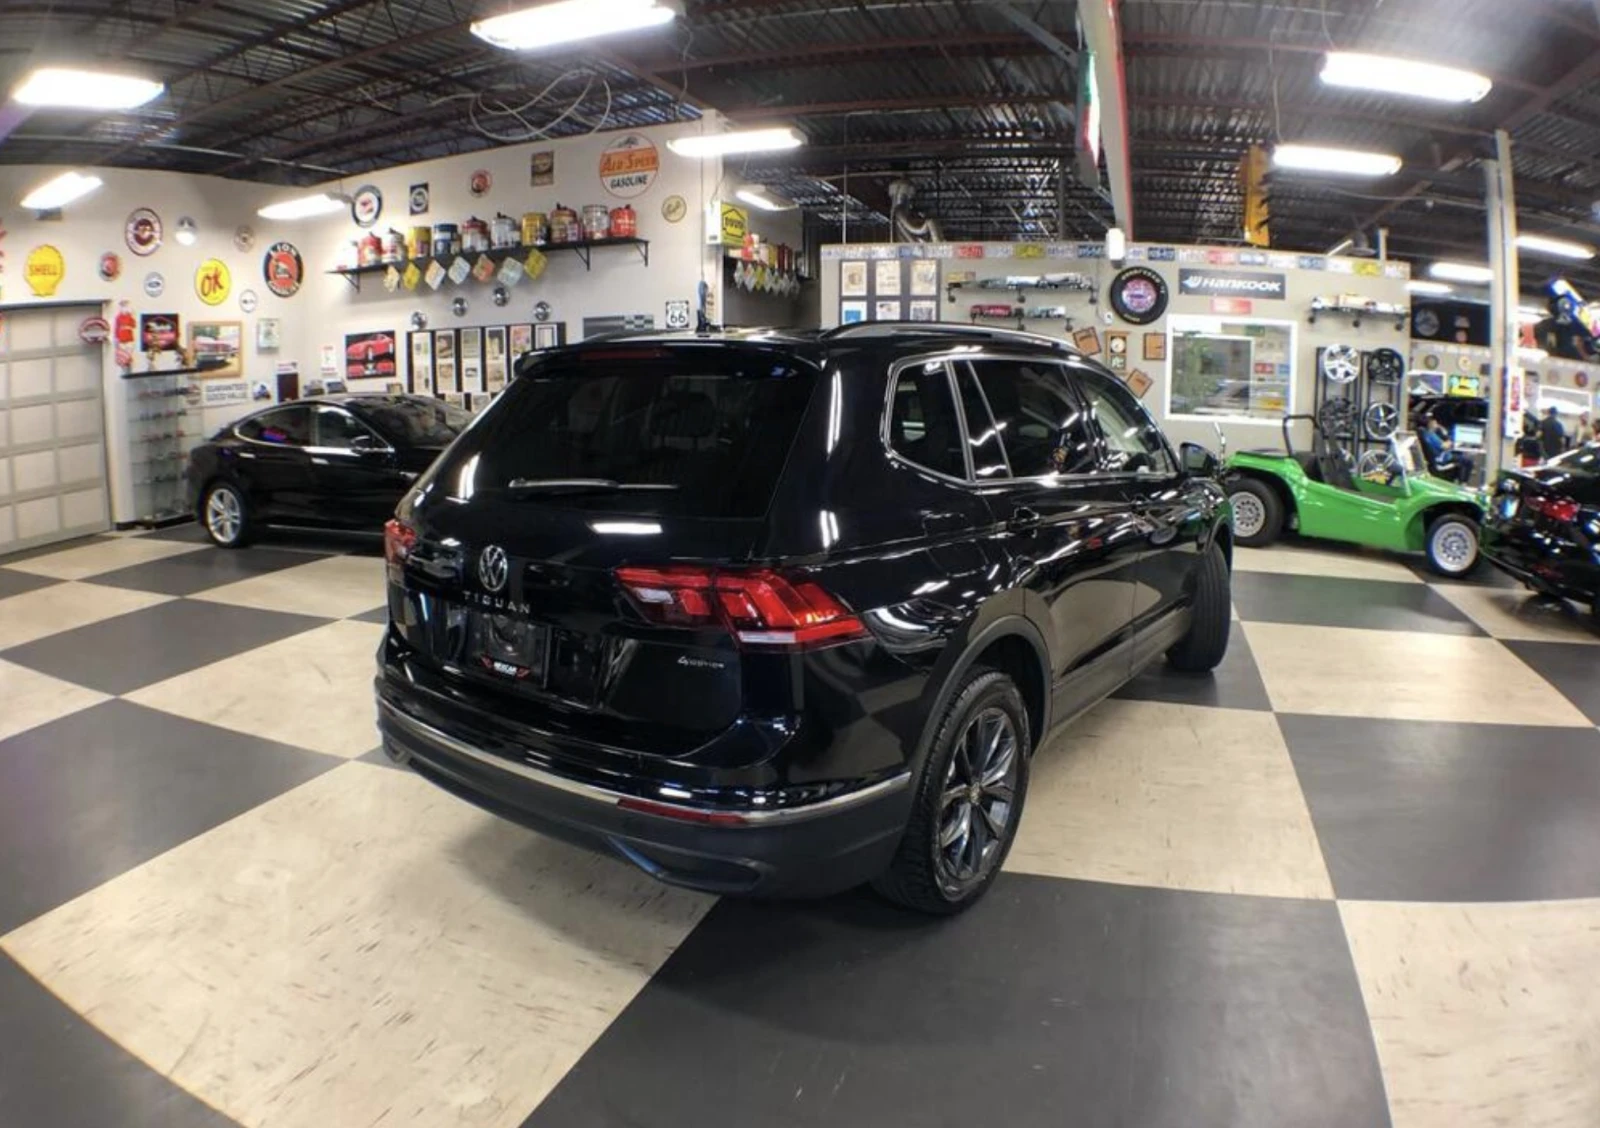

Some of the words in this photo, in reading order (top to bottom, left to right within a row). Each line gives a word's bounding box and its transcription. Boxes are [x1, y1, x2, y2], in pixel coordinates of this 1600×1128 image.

[610, 174, 648, 189] GASOLINE
[28, 263, 58, 277] SHELL
[200, 267, 224, 296] OK
[670, 311, 686, 324] 66
[462, 590, 530, 614] TIGUAN
